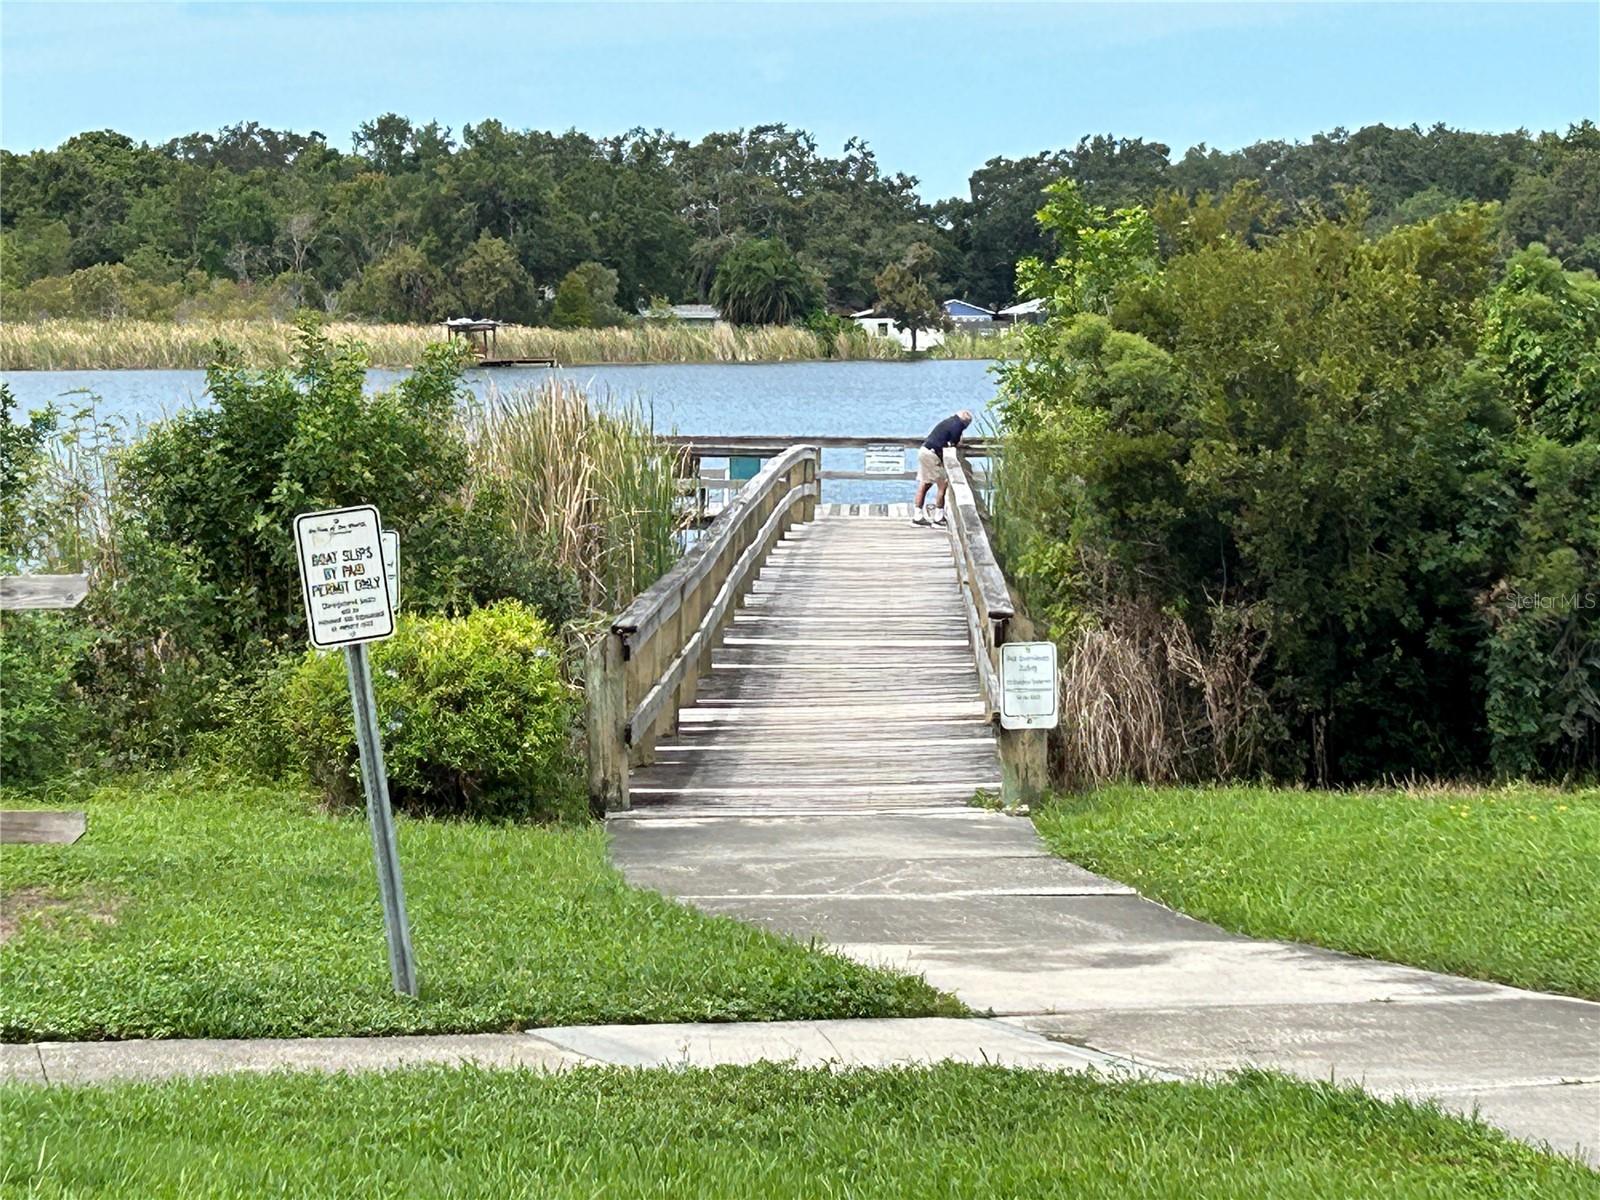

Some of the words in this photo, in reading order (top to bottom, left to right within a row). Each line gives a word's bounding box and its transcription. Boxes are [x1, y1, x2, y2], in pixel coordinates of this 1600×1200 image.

[311, 551, 337, 567] BOAT
[342, 546, 373, 562] SLIPS
[323, 567, 337, 581] BY
[342, 563, 365, 578] PAID
[311, 581, 350, 597] PERMIT
[355, 576, 381, 592] ONLY
